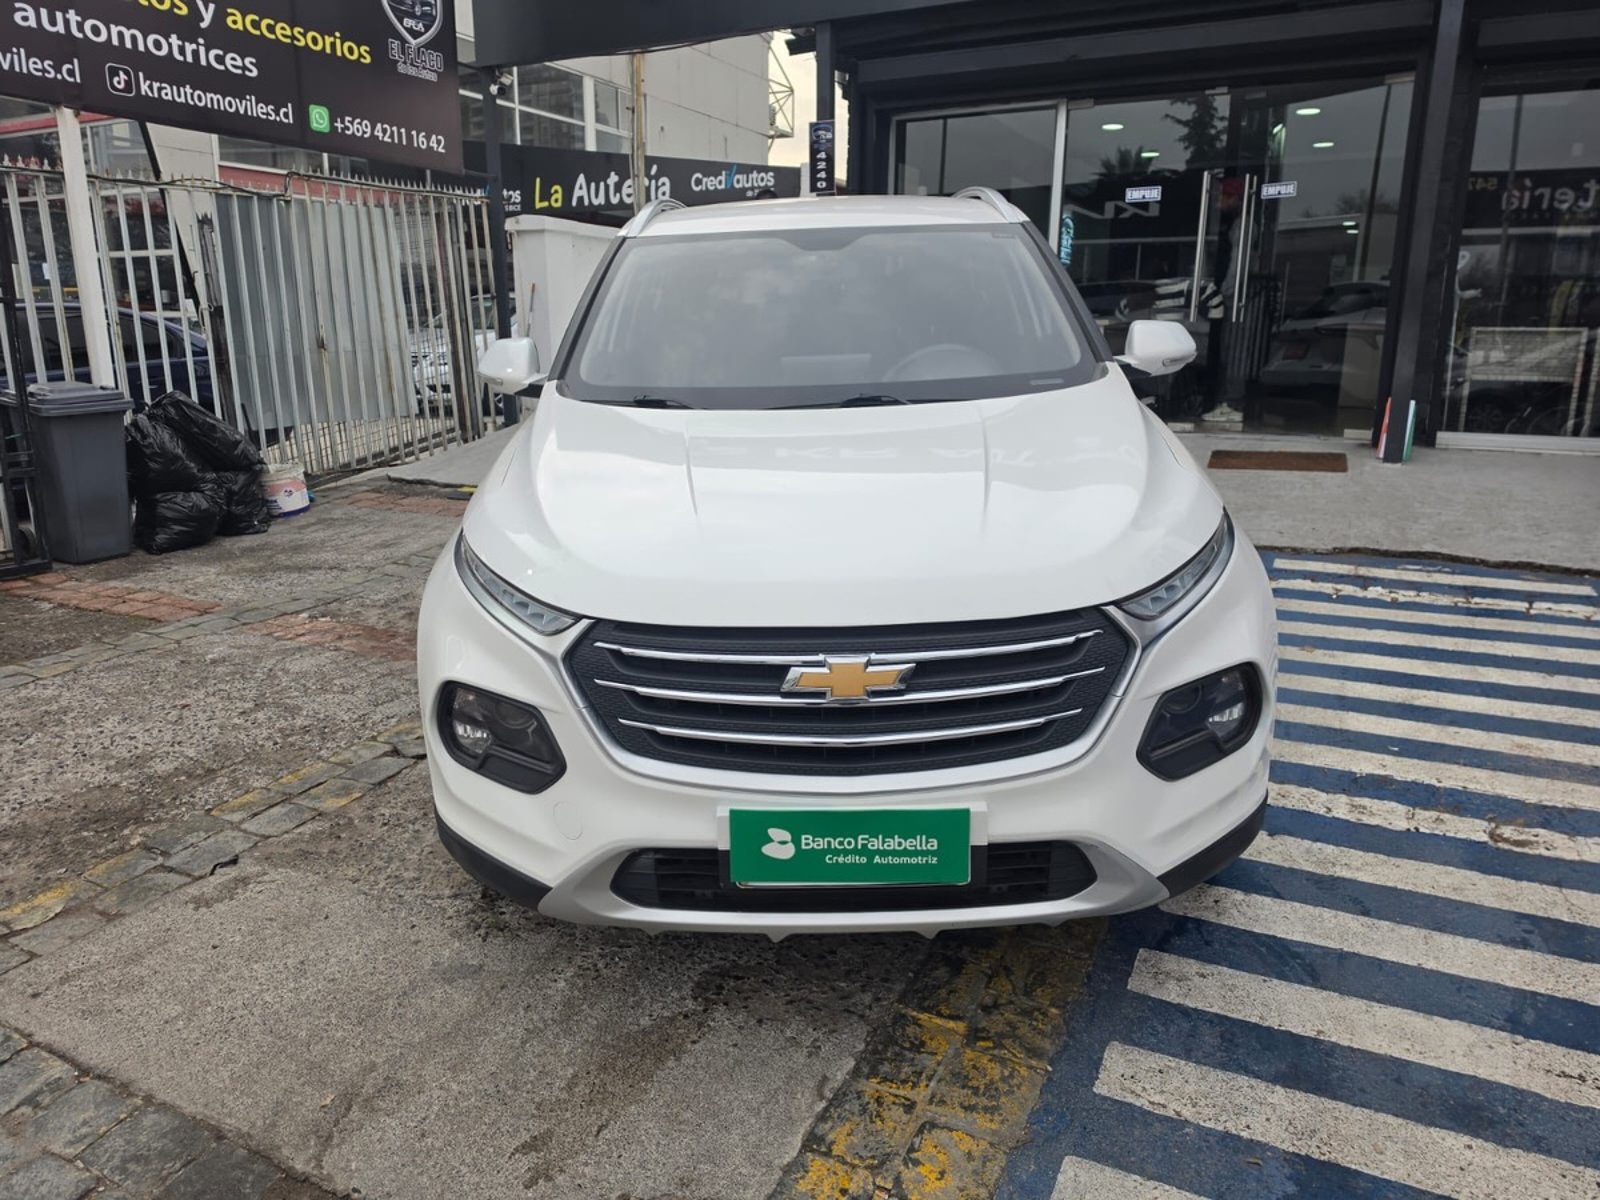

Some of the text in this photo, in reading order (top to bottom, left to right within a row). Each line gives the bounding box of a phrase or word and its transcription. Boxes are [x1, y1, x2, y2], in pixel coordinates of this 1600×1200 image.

[13, 2, 258, 78] automotrices
[195, 0, 372, 64] y accesorios
[388, 38, 405, 61] EL
[405, 44, 444, 72] FLACO
[139, 72, 293, 124] krautomoviles.cl
[334, 116, 446, 153] +569 4211 16 42
[535, 164, 671, 209] La Auteía
[1127, 188, 1159, 200] EMPUJE
[1263, 183, 1295, 196] EMPUJE
[801, 834, 938, 850] Banco Falabella
[825, 854, 938, 864] Crédito Automotriz
